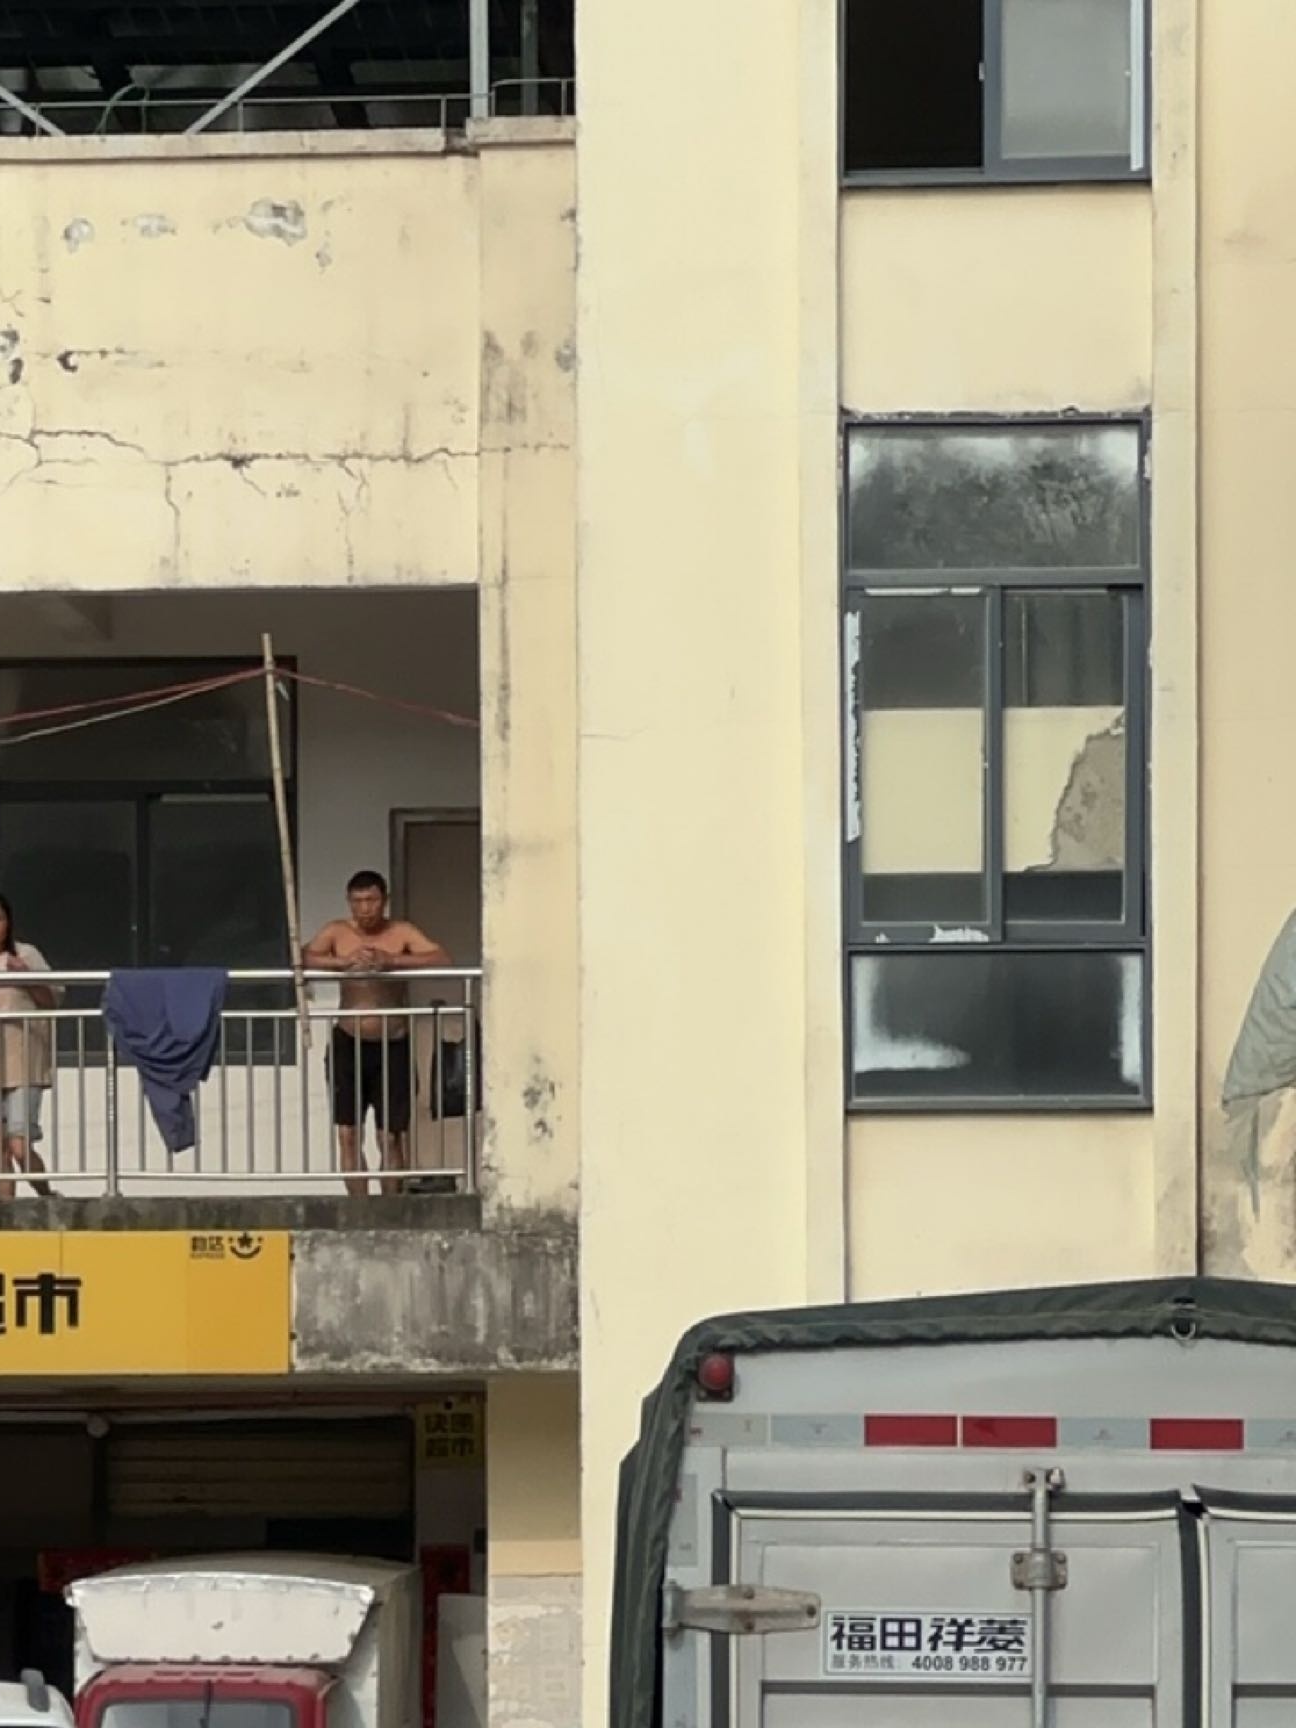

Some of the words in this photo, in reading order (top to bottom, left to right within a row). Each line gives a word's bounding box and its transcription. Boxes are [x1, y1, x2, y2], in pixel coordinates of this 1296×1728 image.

[830, 1616, 1028, 1654] 福田祥菱
[912, 1655, 953, 1671] 4008
[959, 1656, 989, 1671] 988
[995, 1656, 1027, 1671] 977
